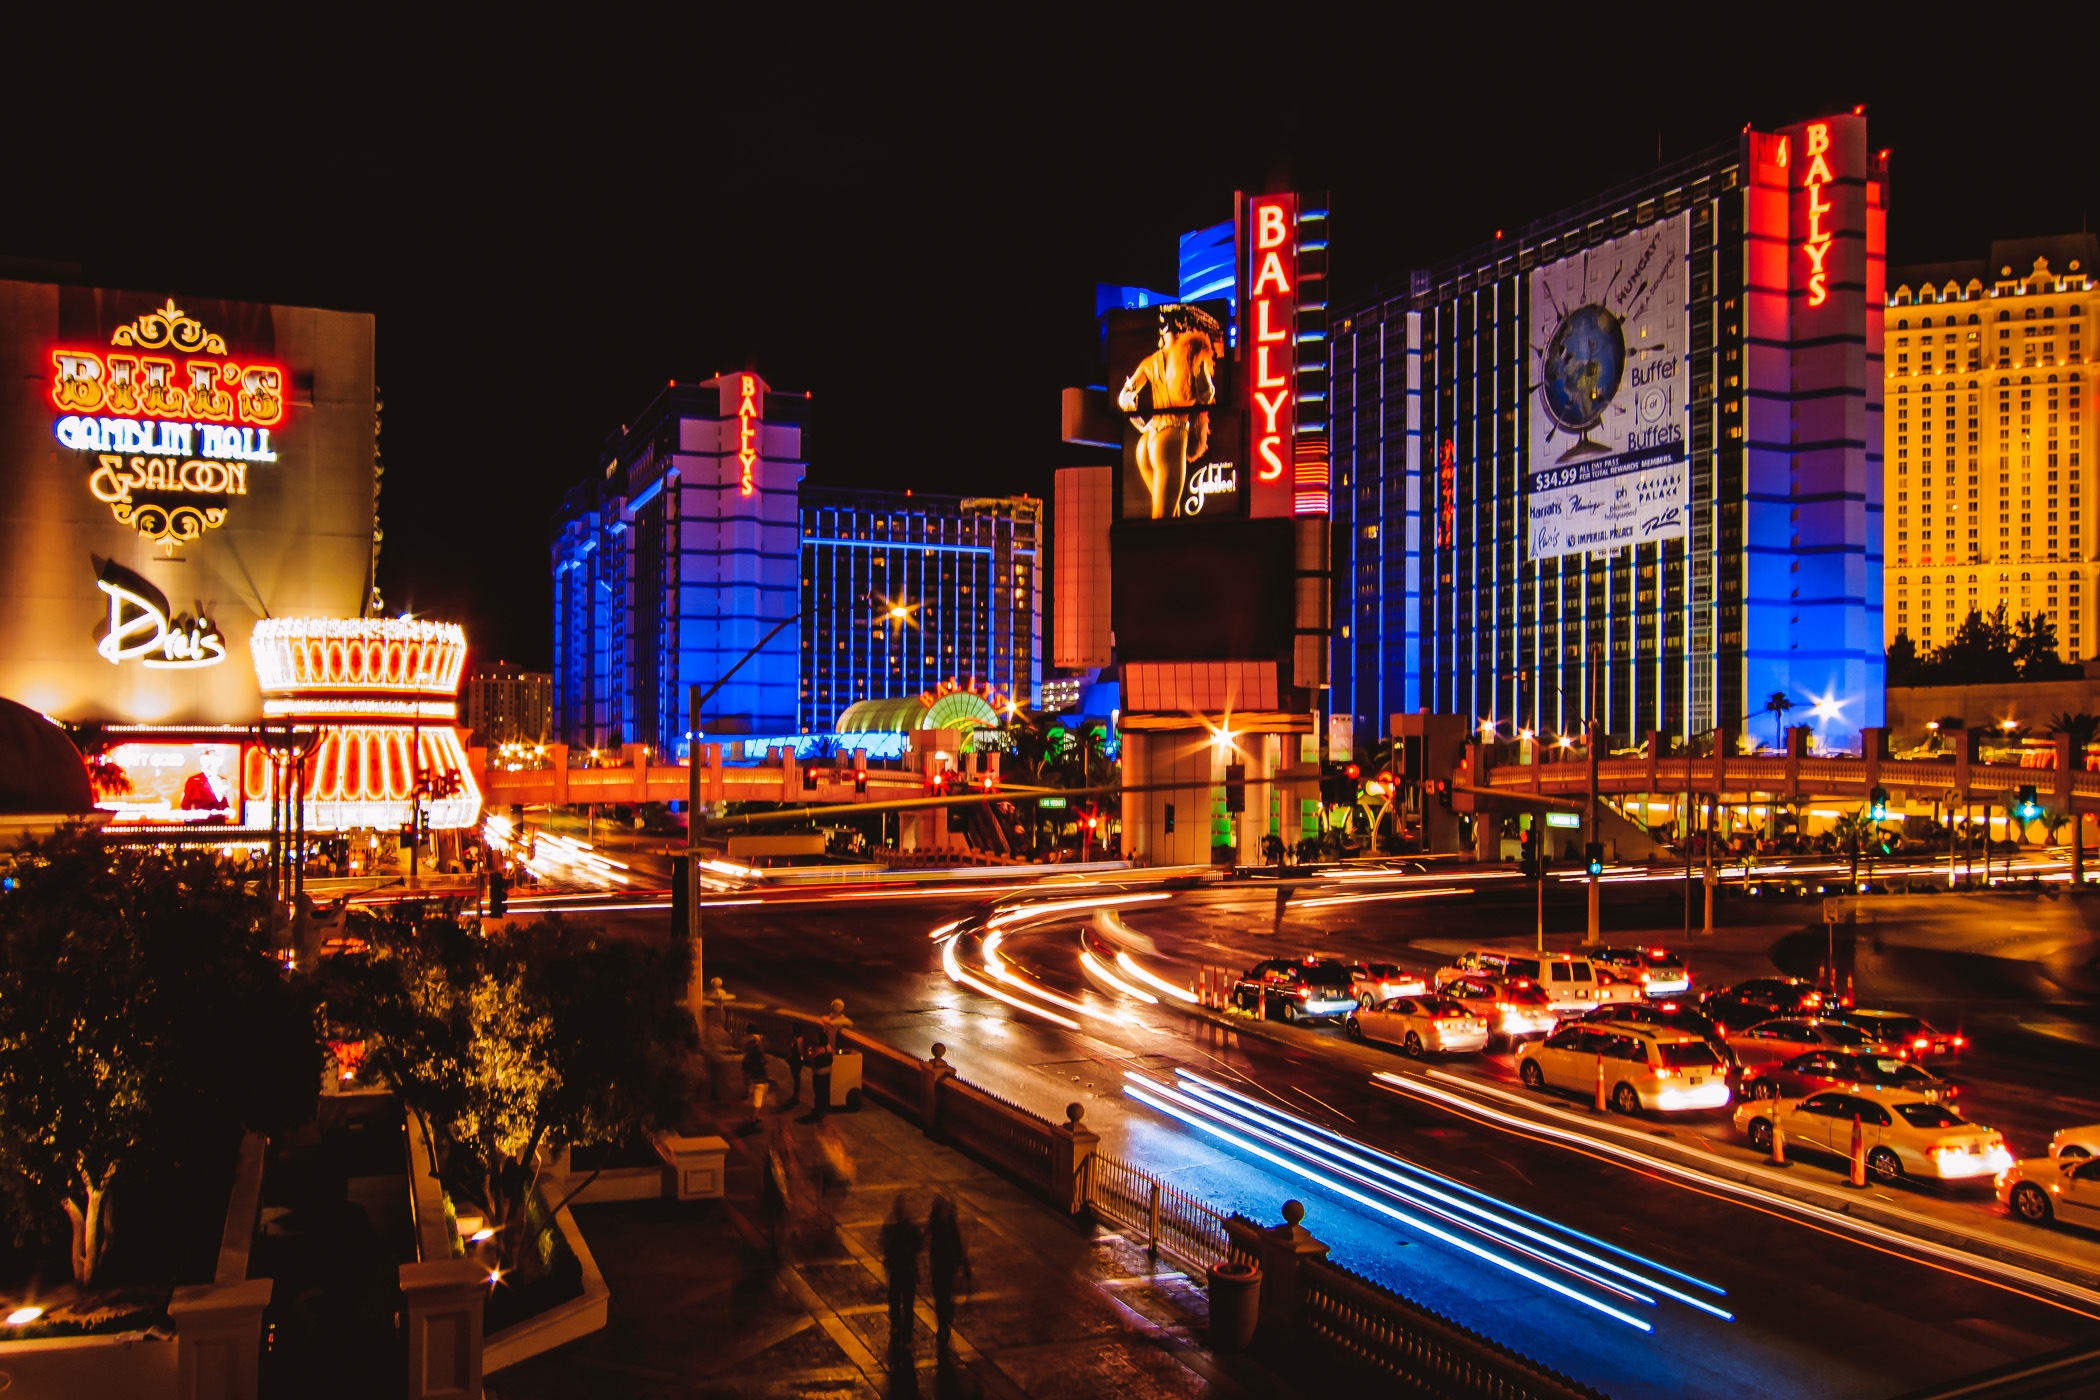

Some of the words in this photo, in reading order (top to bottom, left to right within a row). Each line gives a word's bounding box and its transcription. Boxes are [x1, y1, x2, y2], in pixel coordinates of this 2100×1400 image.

[1804, 123, 1832, 306] BALLYS
[1617, 232, 1661, 305] HUNGRY?
[1254, 205, 1290, 480] BALLYS
[1631, 355, 1677, 388] Buffet
[52, 350, 283, 425] BILL'S
[1649, 398, 1657, 409] of
[201, 423, 278, 462] HALL
[739, 375, 757, 496] BALLYS
[1628, 422, 1681, 452] Buffets
[130, 456, 247, 494] SALOON
[1536, 467, 1577, 492] $34.99
[1579, 464, 1590, 473] ALL
[1591, 461, 1603, 471] DAY
[1604, 458, 1619, 468] PASS
[1579, 472, 1591, 480] FOR
[1592, 468, 1609, 478] TOTAL
[1639, 487, 1677, 504] PALACE
[1641, 507, 1681, 536] Rio
[1577, 531, 1608, 545] IMPERIAL
